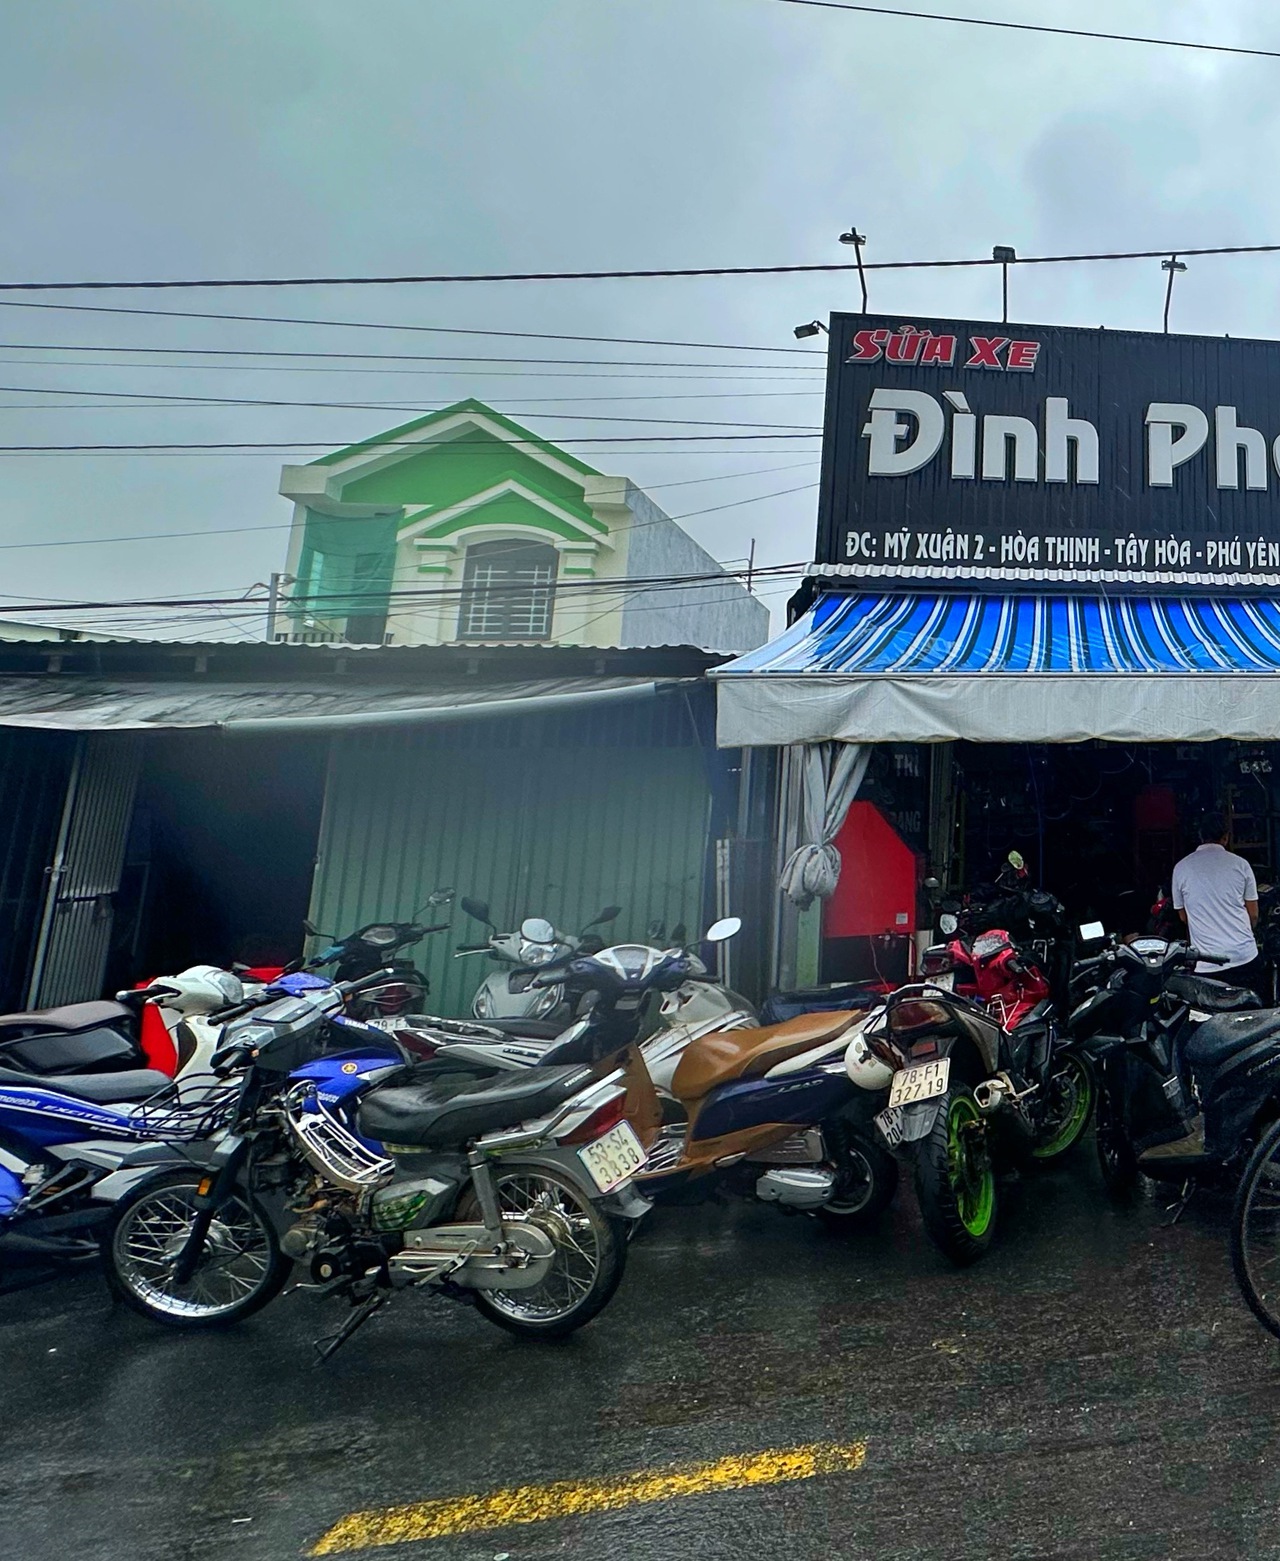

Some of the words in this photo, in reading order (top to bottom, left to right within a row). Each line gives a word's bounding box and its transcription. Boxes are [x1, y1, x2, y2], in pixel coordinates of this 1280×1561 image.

[845, 325, 957, 367] SỬA
[964, 336, 1041, 372] XE
[861, 388, 1099, 484] Đình
[845, 531, 877, 558] ĐC:
[884, 526, 911, 561] MỸ
[915, 527, 969, 561] XUÂN
[973, 534, 984, 560] 2
[1001, 530, 1039, 563] HÒA
[1044, 536, 1100, 568] THỊNH
[1114, 532, 1149, 566] TÂY
[1154, 534, 1191, 567] HÒA
[1206, 535, 1241, 568] PHÚ
[1246, 536, 1280, 569] YÊN
[893, 1077, 944, 1104] 327.19
[901, 1063, 940, 1087] 78-F1
[599, 1147, 641, 1185] 3838
